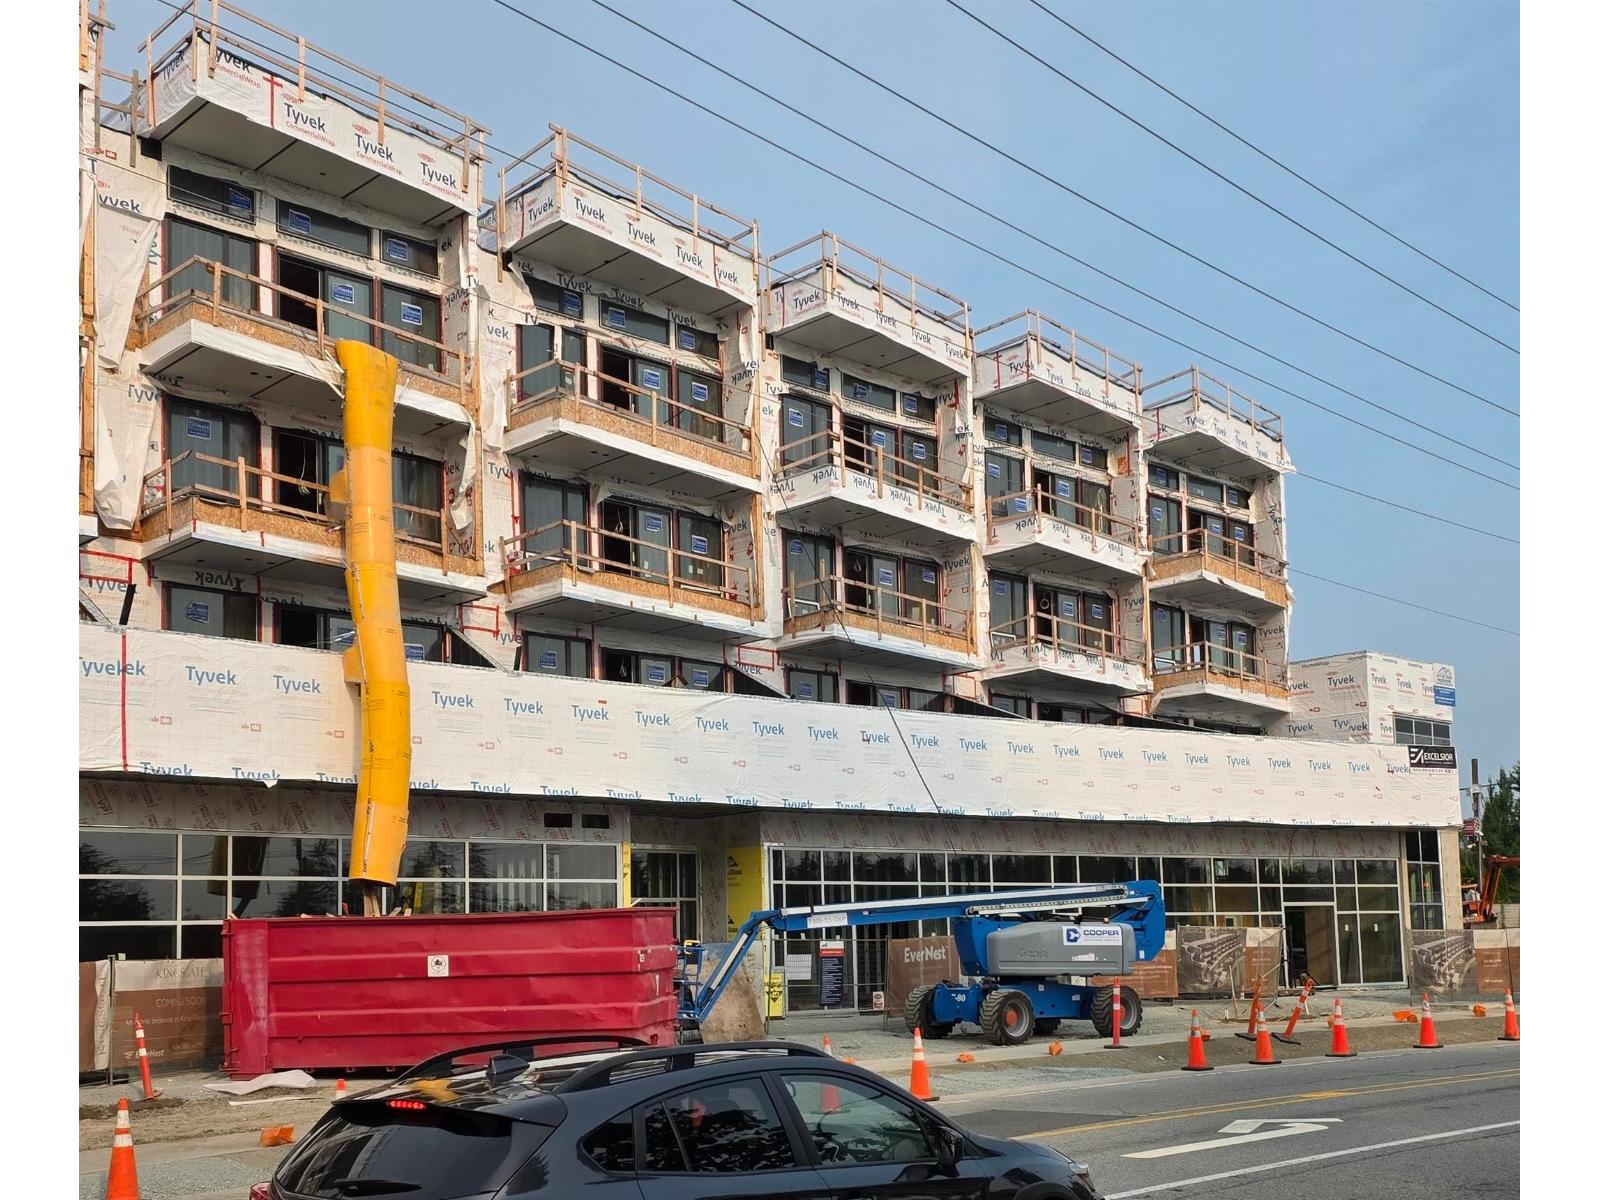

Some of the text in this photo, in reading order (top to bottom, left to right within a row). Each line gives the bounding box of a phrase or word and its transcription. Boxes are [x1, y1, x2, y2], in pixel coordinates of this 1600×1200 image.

[216, 50, 251, 74] yvek
[216, 65, 262, 88] mmercialWrap
[284, 102, 327, 133] Tyvek
[355, 133, 394, 162] Tyvek
[420, 162, 457, 189] Tyvek
[99, 194, 141, 214] yvek
[528, 197, 554, 221] Tyvek
[574, 197, 606, 222] Tyvek
[627, 222, 656, 246] Tyvek
[149, 231, 162, 265] Tyve
[676, 246, 703, 267] Tyvek
[716, 263, 738, 283] yvek
[556, 273, 593, 294] Tyvek
[612, 289, 644, 310] Tyvek
[793, 290, 820, 309] Tyvek
[837, 292, 860, 311] Tyvek
[666, 309, 697, 328] Tyvek
[875, 309, 897, 328] Tyvek
[487, 325, 510, 339] vek
[1046, 368, 1065, 385] Tyvek
[765, 382, 783, 394] Tyv
[939, 393, 956, 406] Tyv
[1101, 396, 1118, 411] Tyvek
[1213, 423, 1228, 437] Tyvek
[1235, 434, 1249, 449] Tyvek
[1256, 446, 1270, 459] Tyvek
[488, 462, 511, 481] Tyv
[769, 480, 796, 495] Tyvek
[890, 490, 913, 507] Tyvek
[925, 501, 946, 517] Tyvek
[943, 556, 970, 572] Tyvek
[88, 577, 137, 594] Tyve
[195, 570, 247, 591] Tyvek
[1124, 597, 1145, 609] Tyve
[496, 632, 522, 645] Tyve
[185, 664, 236, 685] Tyvek
[1328, 675, 1355, 686] Tyvek
[1372, 674, 1387, 684] Tyvek
[273, 675, 321, 694] Tyvek
[1287, 683, 1309, 691] yvek
[1397, 679, 1412, 689] Tyvek
[1421, 683, 1434, 693] Tyve
[432, 691, 473, 708] Tyvek
[504, 698, 543, 715] Tyvek
[572, 705, 609, 722] Tyvek
[635, 711, 670, 727] Tyvek
[696, 716, 729, 732] Tyvek
[752, 721, 785, 737] Tyvek
[1287, 724, 1314, 734] Tyvek
[1333, 719, 1350, 729] Tyv
[1380, 723, 1392, 733] Tyve
[807, 726, 839, 741] Tyvek
[860, 731, 890, 745] Tyvek
[911, 734, 939, 749] Tyvek
[959, 738, 987, 752] Tyvek
[1007, 741, 1034, 755] Tyvek
[1053, 744, 1080, 758] Tyvek
[1098, 747, 1124, 761] Tyvek
[1142, 750, 1167, 763] Tyvek
[1184, 753, 1209, 766] Tyvek
[1227, 755, 1250, 768] Tyvek
[1268, 758, 1291, 769] Tyvek
[1309, 760, 1331, 770] Tyvek
[1348, 762, 1370, 772] Tyvek
[1387, 764, 1409, 774] Tyvek
[410, 779, 440, 790] yvek
[904, 945, 946, 963] EverNest
